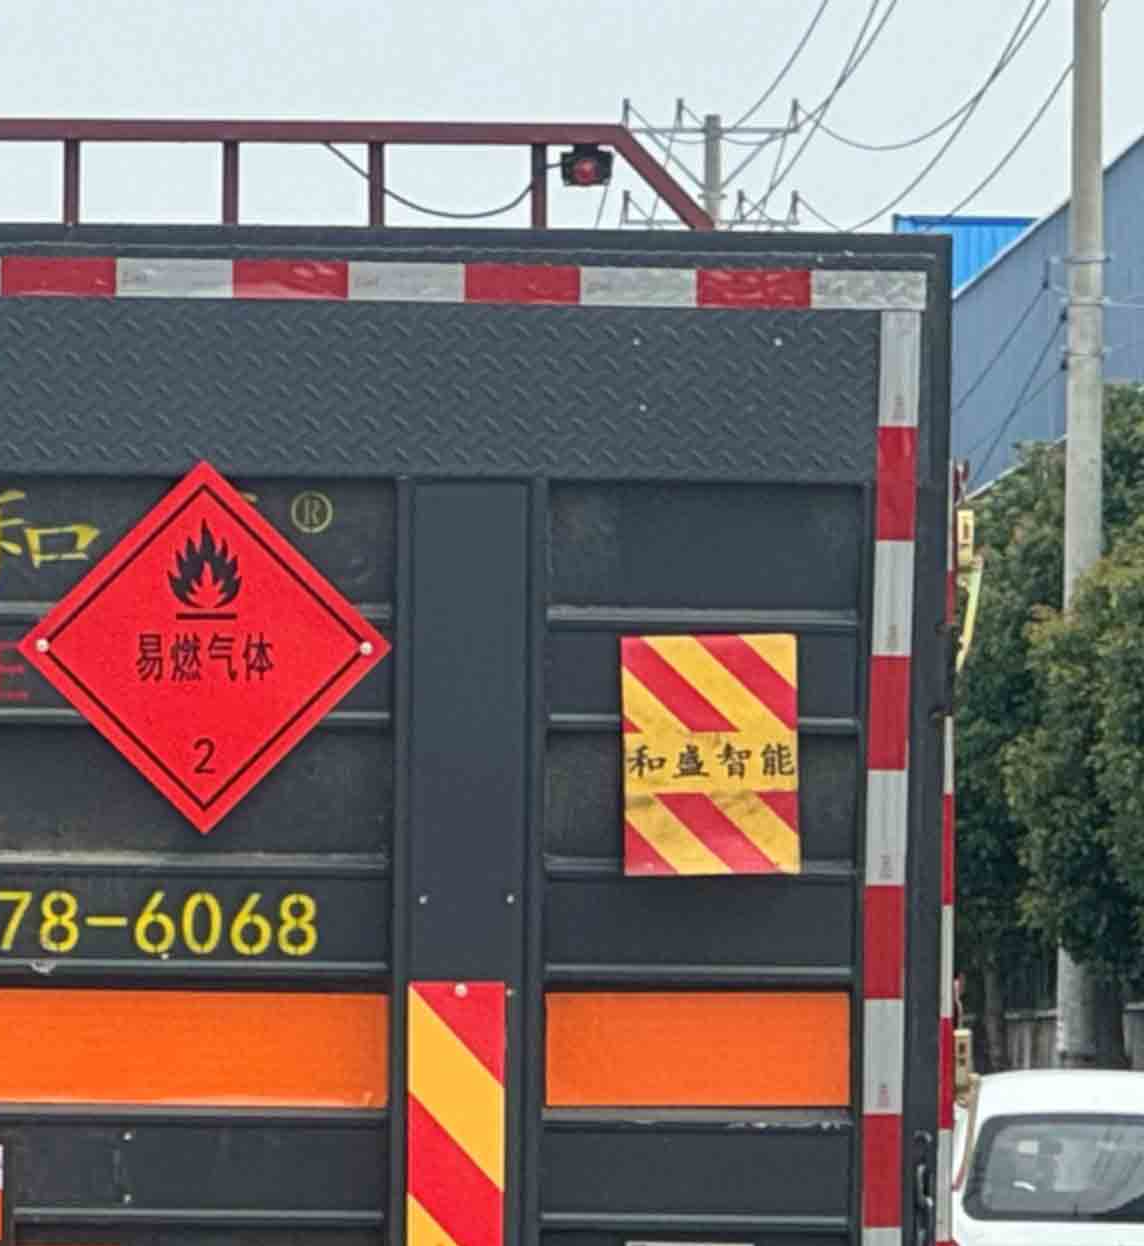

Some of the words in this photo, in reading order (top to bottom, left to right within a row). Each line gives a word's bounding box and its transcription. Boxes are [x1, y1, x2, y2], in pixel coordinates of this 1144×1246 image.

[135, 632, 276, 682] 易燃气体
[191, 738, 217, 775] 2
[628, 743, 795, 779] 和盛智能
